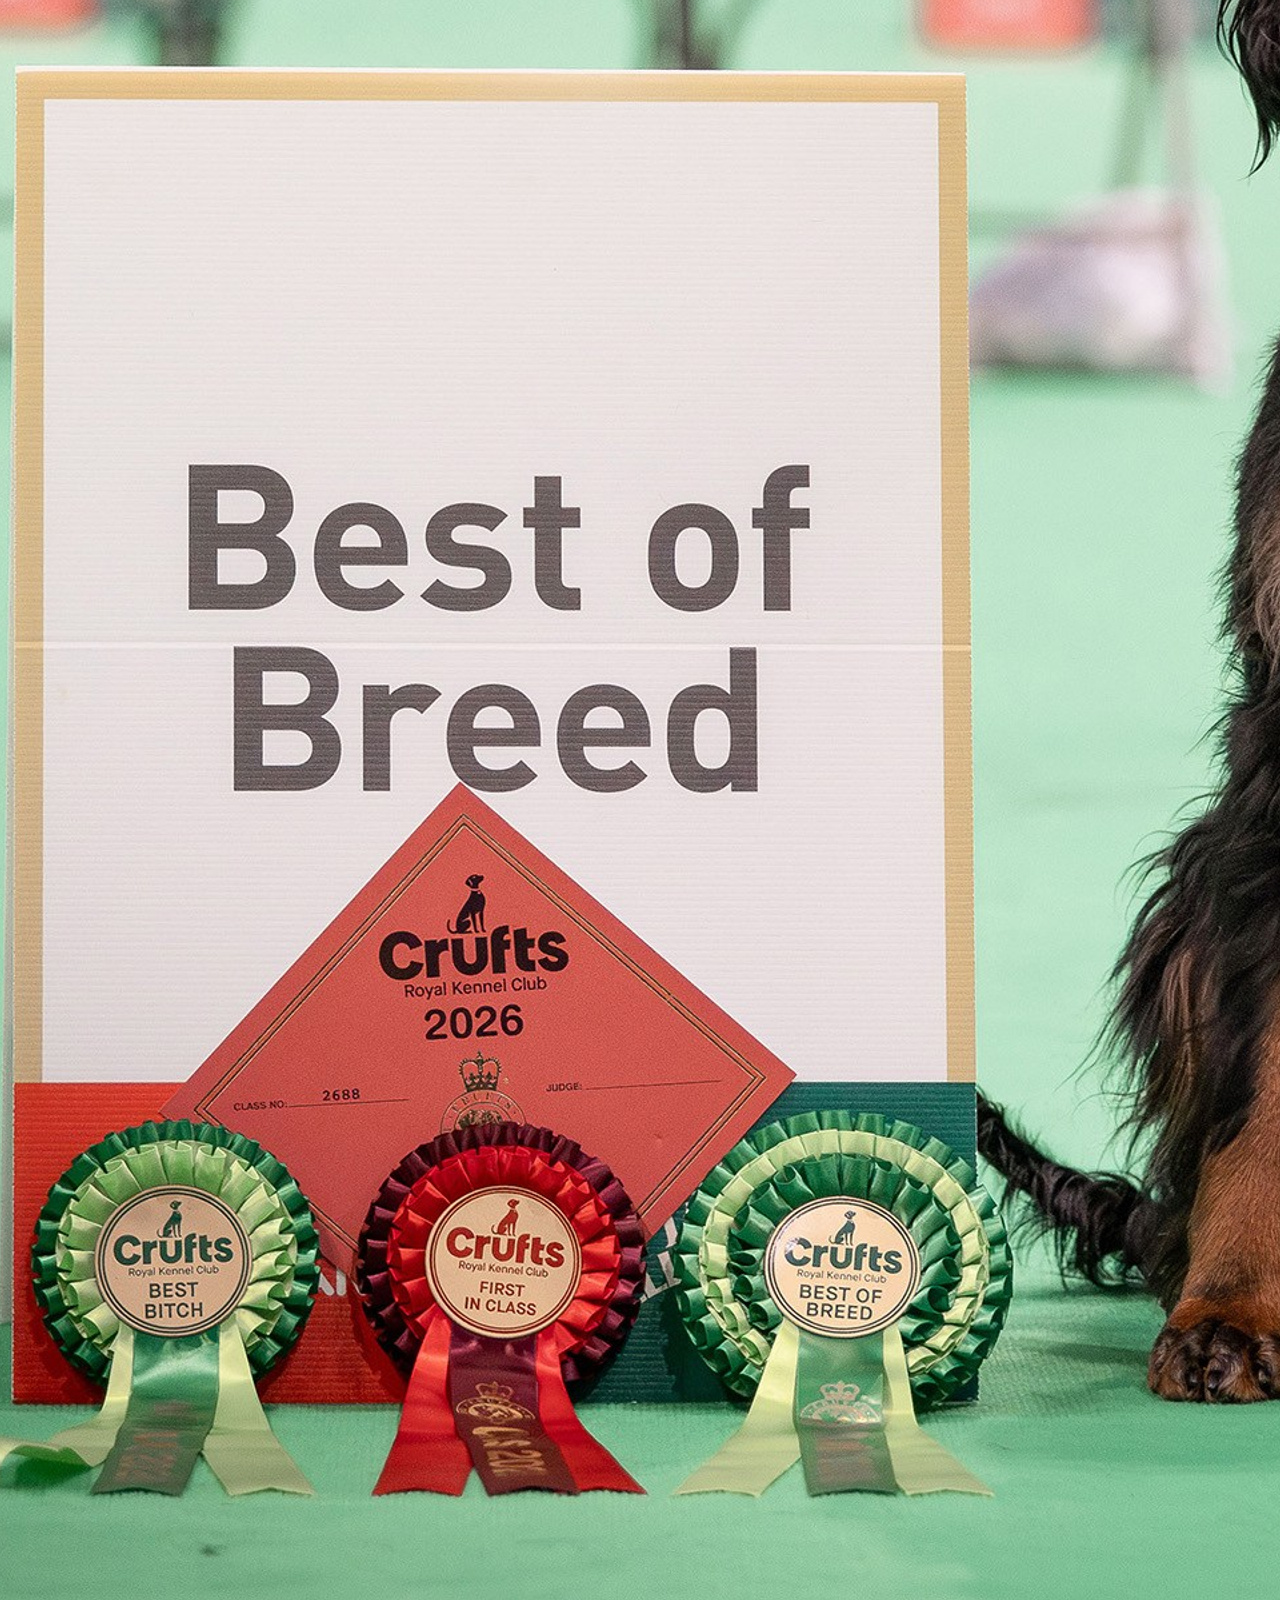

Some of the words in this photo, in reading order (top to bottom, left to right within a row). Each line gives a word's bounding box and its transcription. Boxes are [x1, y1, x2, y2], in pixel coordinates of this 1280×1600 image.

[188, 464, 582, 612] Best
[647, 464, 811, 612] of
[233, 646, 758, 793] Breed
[378, 925, 570, 981] Crufts
[404, 982, 447, 1000] Royal
[452, 979, 507, 995] Kennel
[511, 976, 548, 991] Club
[424, 1004, 524, 1041] 2026
[322, 1088, 361, 1101] 2688
[546, 1082, 582, 1092] JUDGE:
[233, 1102, 267, 1111] CLASS
[113, 1233, 234, 1266] Crufts
[446, 1227, 565, 1268] Crufts
[784, 1236, 903, 1274] Crufts
[128, 1267, 156, 1278] Royal
[159, 1266, 194, 1276] Kennel
[196, 1265, 220, 1275] Club
[458, 1260, 486, 1273] Royal
[488, 1264, 524, 1275] Kennel
[525, 1266, 549, 1278] Club
[796, 1269, 824, 1281] Royal
[826, 1271, 862, 1282] Kennel
[864, 1274, 887, 1284] Club
[149, 1282, 199, 1299] BEST
[480, 1281, 526, 1297] FIRST
[799, 1284, 850, 1301] BEST
[856, 1288, 883, 1304] OF
[145, 1302, 203, 1319] BITCH
[464, 1296, 480, 1311] IN
[485, 1299, 537, 1316] CLASS
[806, 1302, 873, 1320] BREED
